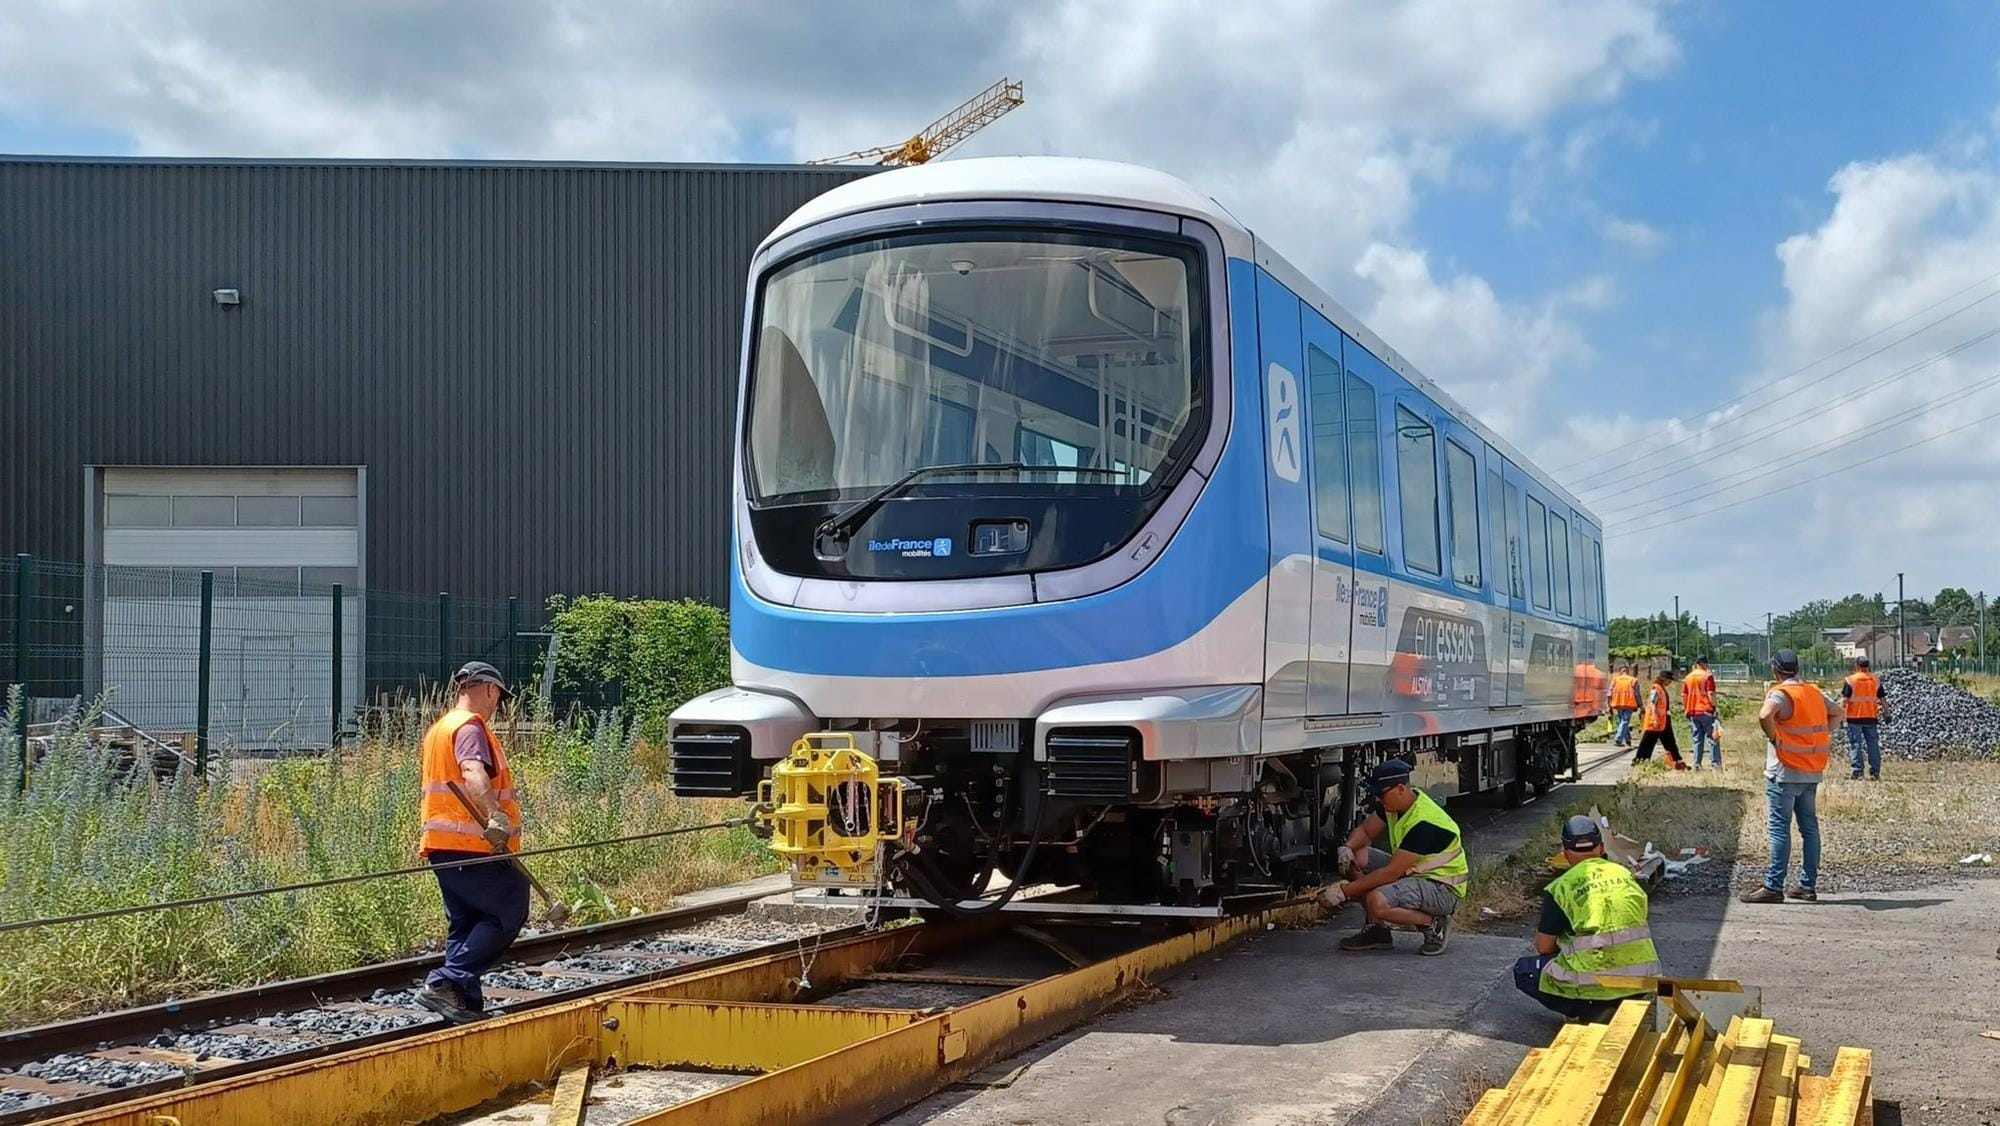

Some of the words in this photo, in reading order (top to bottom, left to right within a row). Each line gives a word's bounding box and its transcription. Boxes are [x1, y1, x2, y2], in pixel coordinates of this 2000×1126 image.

[902, 549, 931, 557] mobilités
[1415, 616, 1432, 659] en
[1437, 620, 1474, 664] essais
